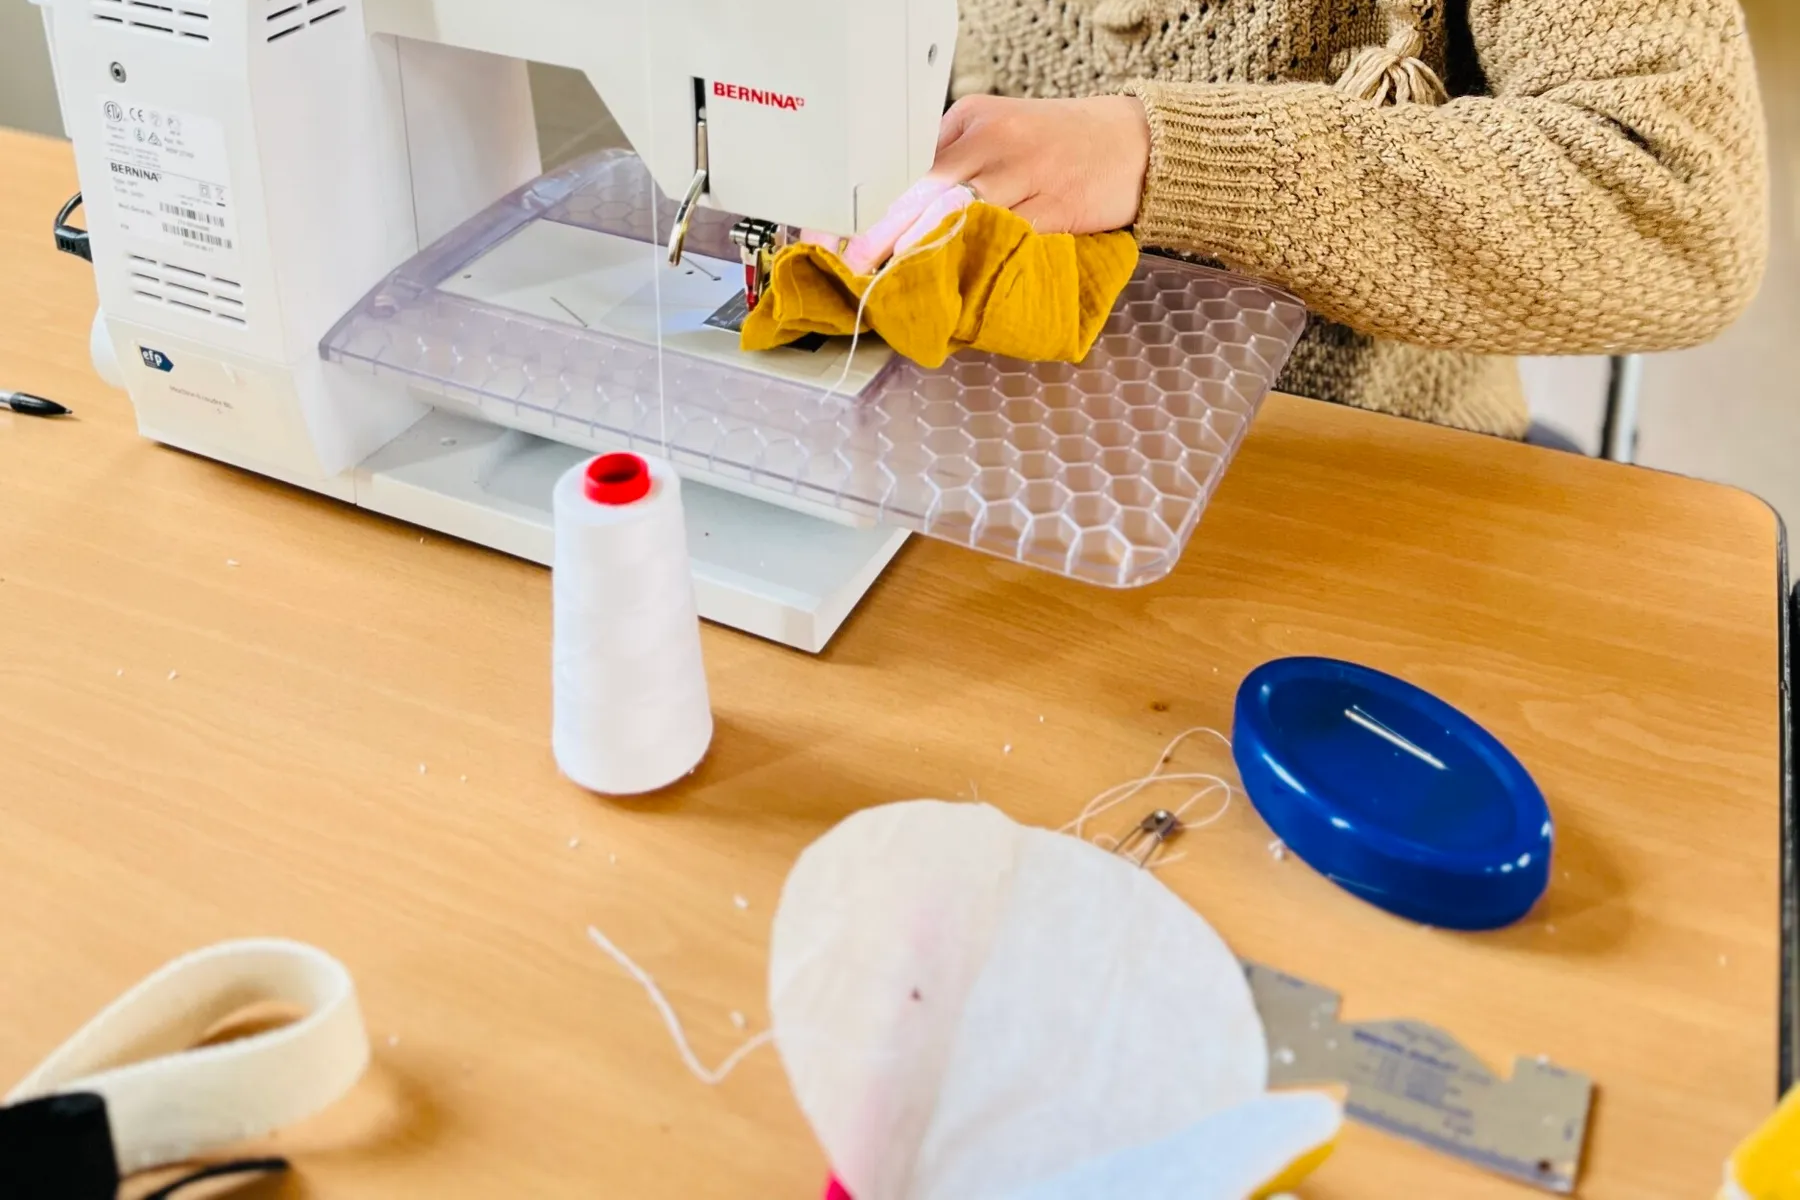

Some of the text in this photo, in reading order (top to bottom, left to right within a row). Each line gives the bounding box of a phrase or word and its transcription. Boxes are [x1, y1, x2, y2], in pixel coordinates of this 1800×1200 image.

[713, 81, 798, 111] BERNINA
[110, 162, 159, 182] BERNINA
[142, 350, 163, 366] efp
